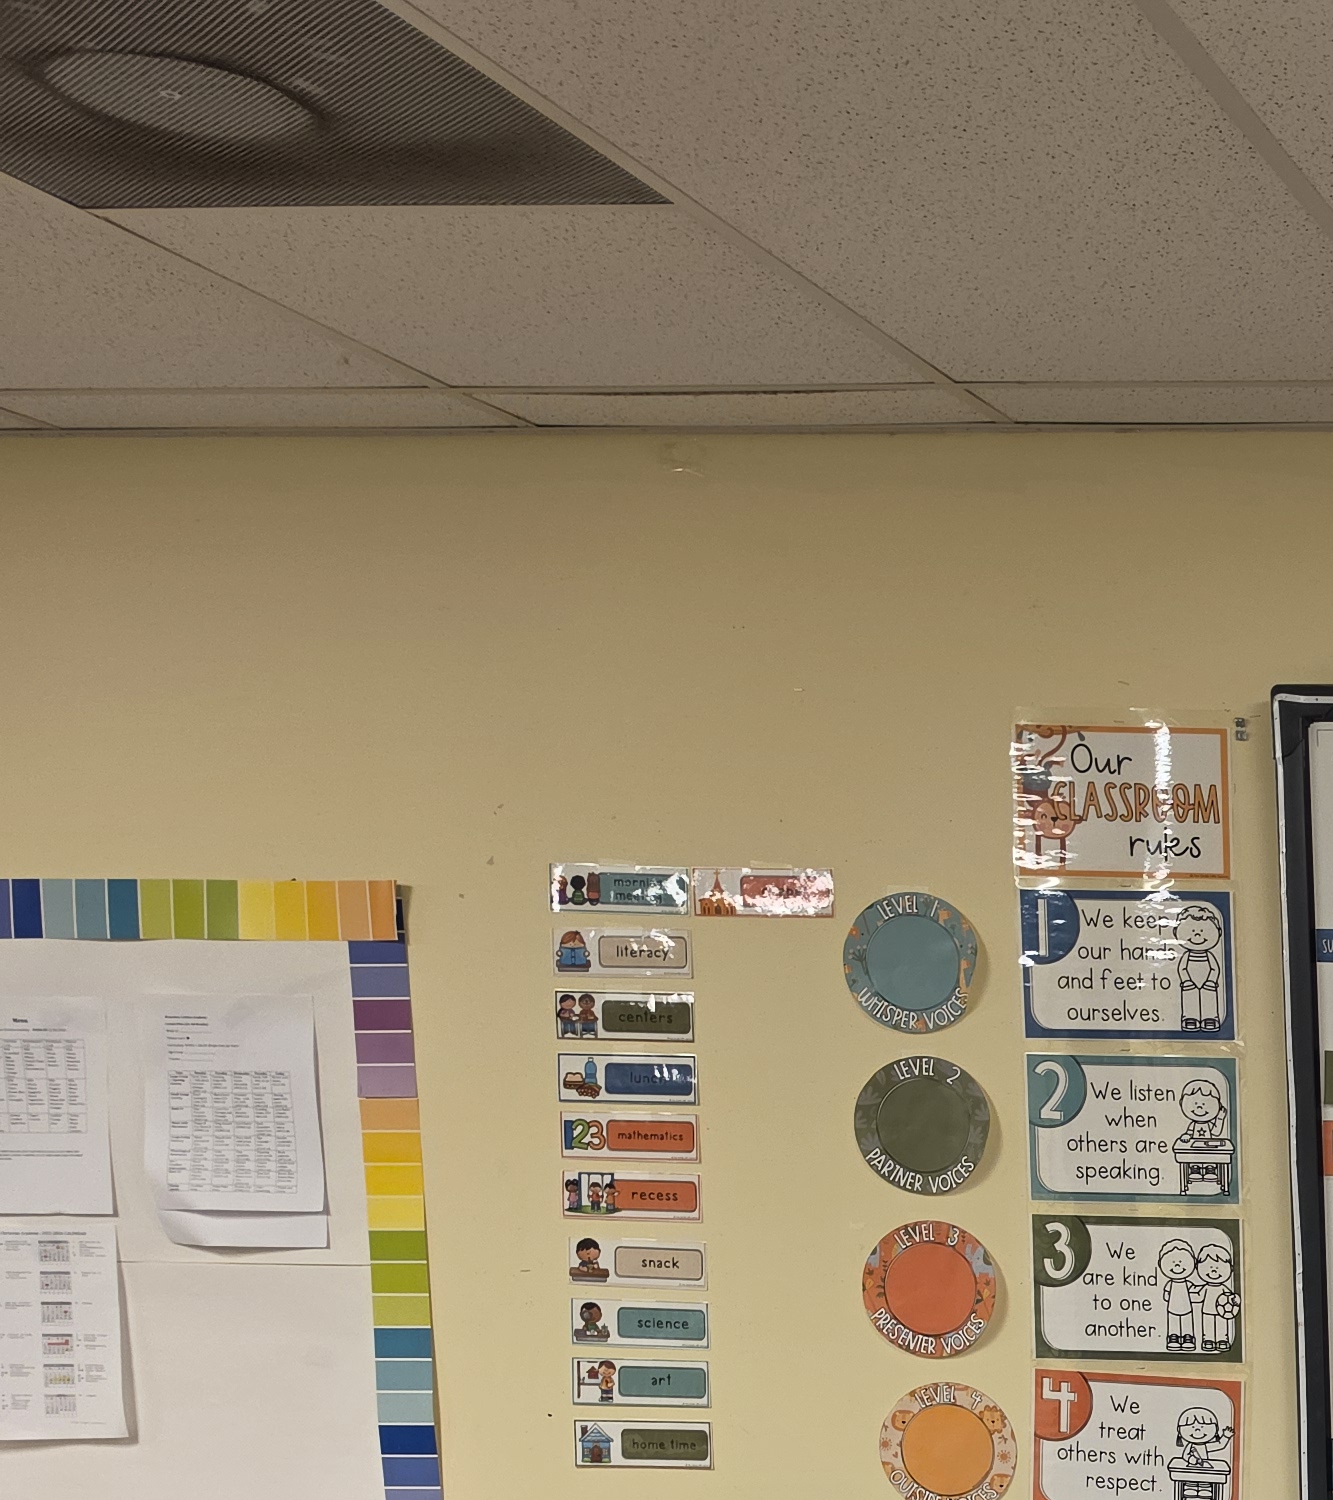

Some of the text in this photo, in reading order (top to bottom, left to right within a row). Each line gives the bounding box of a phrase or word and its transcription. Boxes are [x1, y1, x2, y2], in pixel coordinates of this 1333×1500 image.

[1070, 743, 1132, 775] Our
[1051, 781, 1220, 824] CLASSROOM
[1129, 827, 1202, 861] rules
[877, 896, 938, 921] LEVEL 1
[616, 945, 669, 962] literacy
[618, 1009, 673, 1024] centers
[858, 987, 968, 1030] WHISPER VOICES
[894, 1058, 961, 1085] LEVEL 2
[1033, 1060, 1067, 1121] 2
[1090, 1081, 1176, 1103] We listen
[1105, 1109, 1157, 1129] when
[617, 1129, 684, 1142] mathematics
[1067, 1135, 1169, 1155] others are
[866, 1147, 975, 1194] PARTNER VOICES
[1075, 1161, 1165, 1193] speaking.
[631, 1190, 679, 1202] recess
[894, 1223, 960, 1250] LEVEL 3
[1043, 1221, 1074, 1279] 3
[1106, 1242, 1136, 1261] We
[641, 1257, 680, 1269] snack
[1083, 1266, 1159, 1288] are kind
[1093, 1294, 1152, 1312] to one
[637, 1318, 690, 1330] science
[870, 1307, 986, 1355] PRESENTER VOICES
[1084, 1319, 1161, 1339] another.
[651, 1374, 672, 1386] art
[914, 1385, 983, 1410] LEVEL 4
[1041, 1377, 1078, 1433] 4
[1110, 1396, 1141, 1416] We
[1099, 1421, 1146, 1442] treat
[632, 1438, 697, 1452] home time
[1057, 1445, 1165, 1468] others with
[1085, 1473, 1163, 1499] respect.
